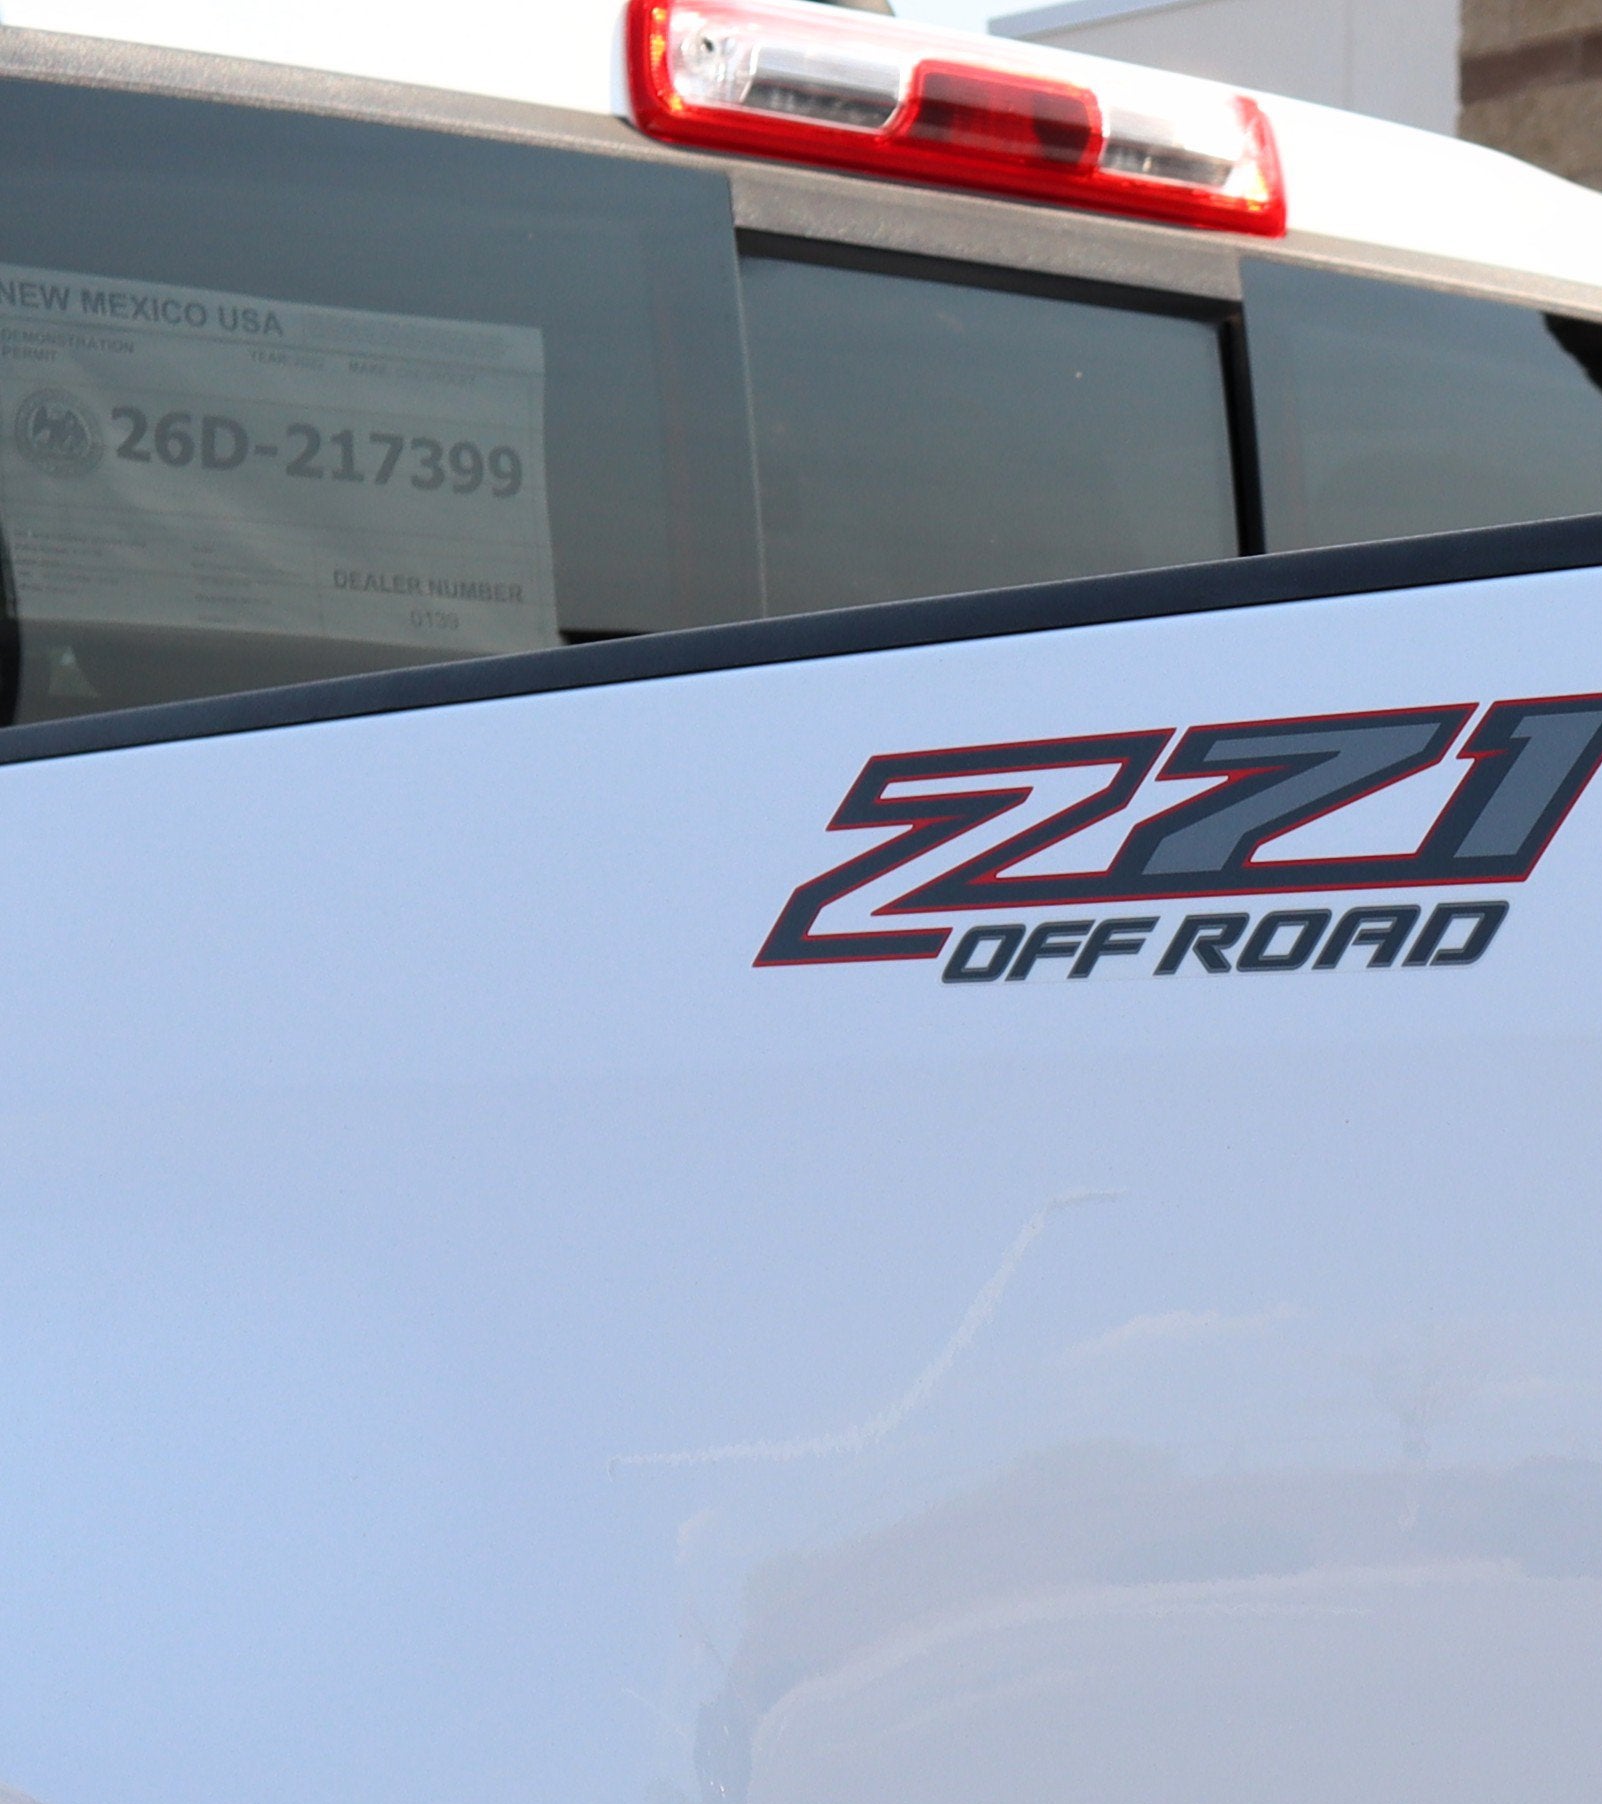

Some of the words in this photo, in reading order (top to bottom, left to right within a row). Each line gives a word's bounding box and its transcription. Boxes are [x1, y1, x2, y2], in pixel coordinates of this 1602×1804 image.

[0, 280, 71, 312] NEW
[81, 287, 208, 329] MEXICO
[217, 304, 285, 337] USA
[110, 405, 524, 499] 26D-217399
[332, 568, 422, 596] DEALER
[427, 577, 525, 605] NUMBER
[941, 915, 1160, 985] OFF
[1153, 900, 1510, 976] ROAD
